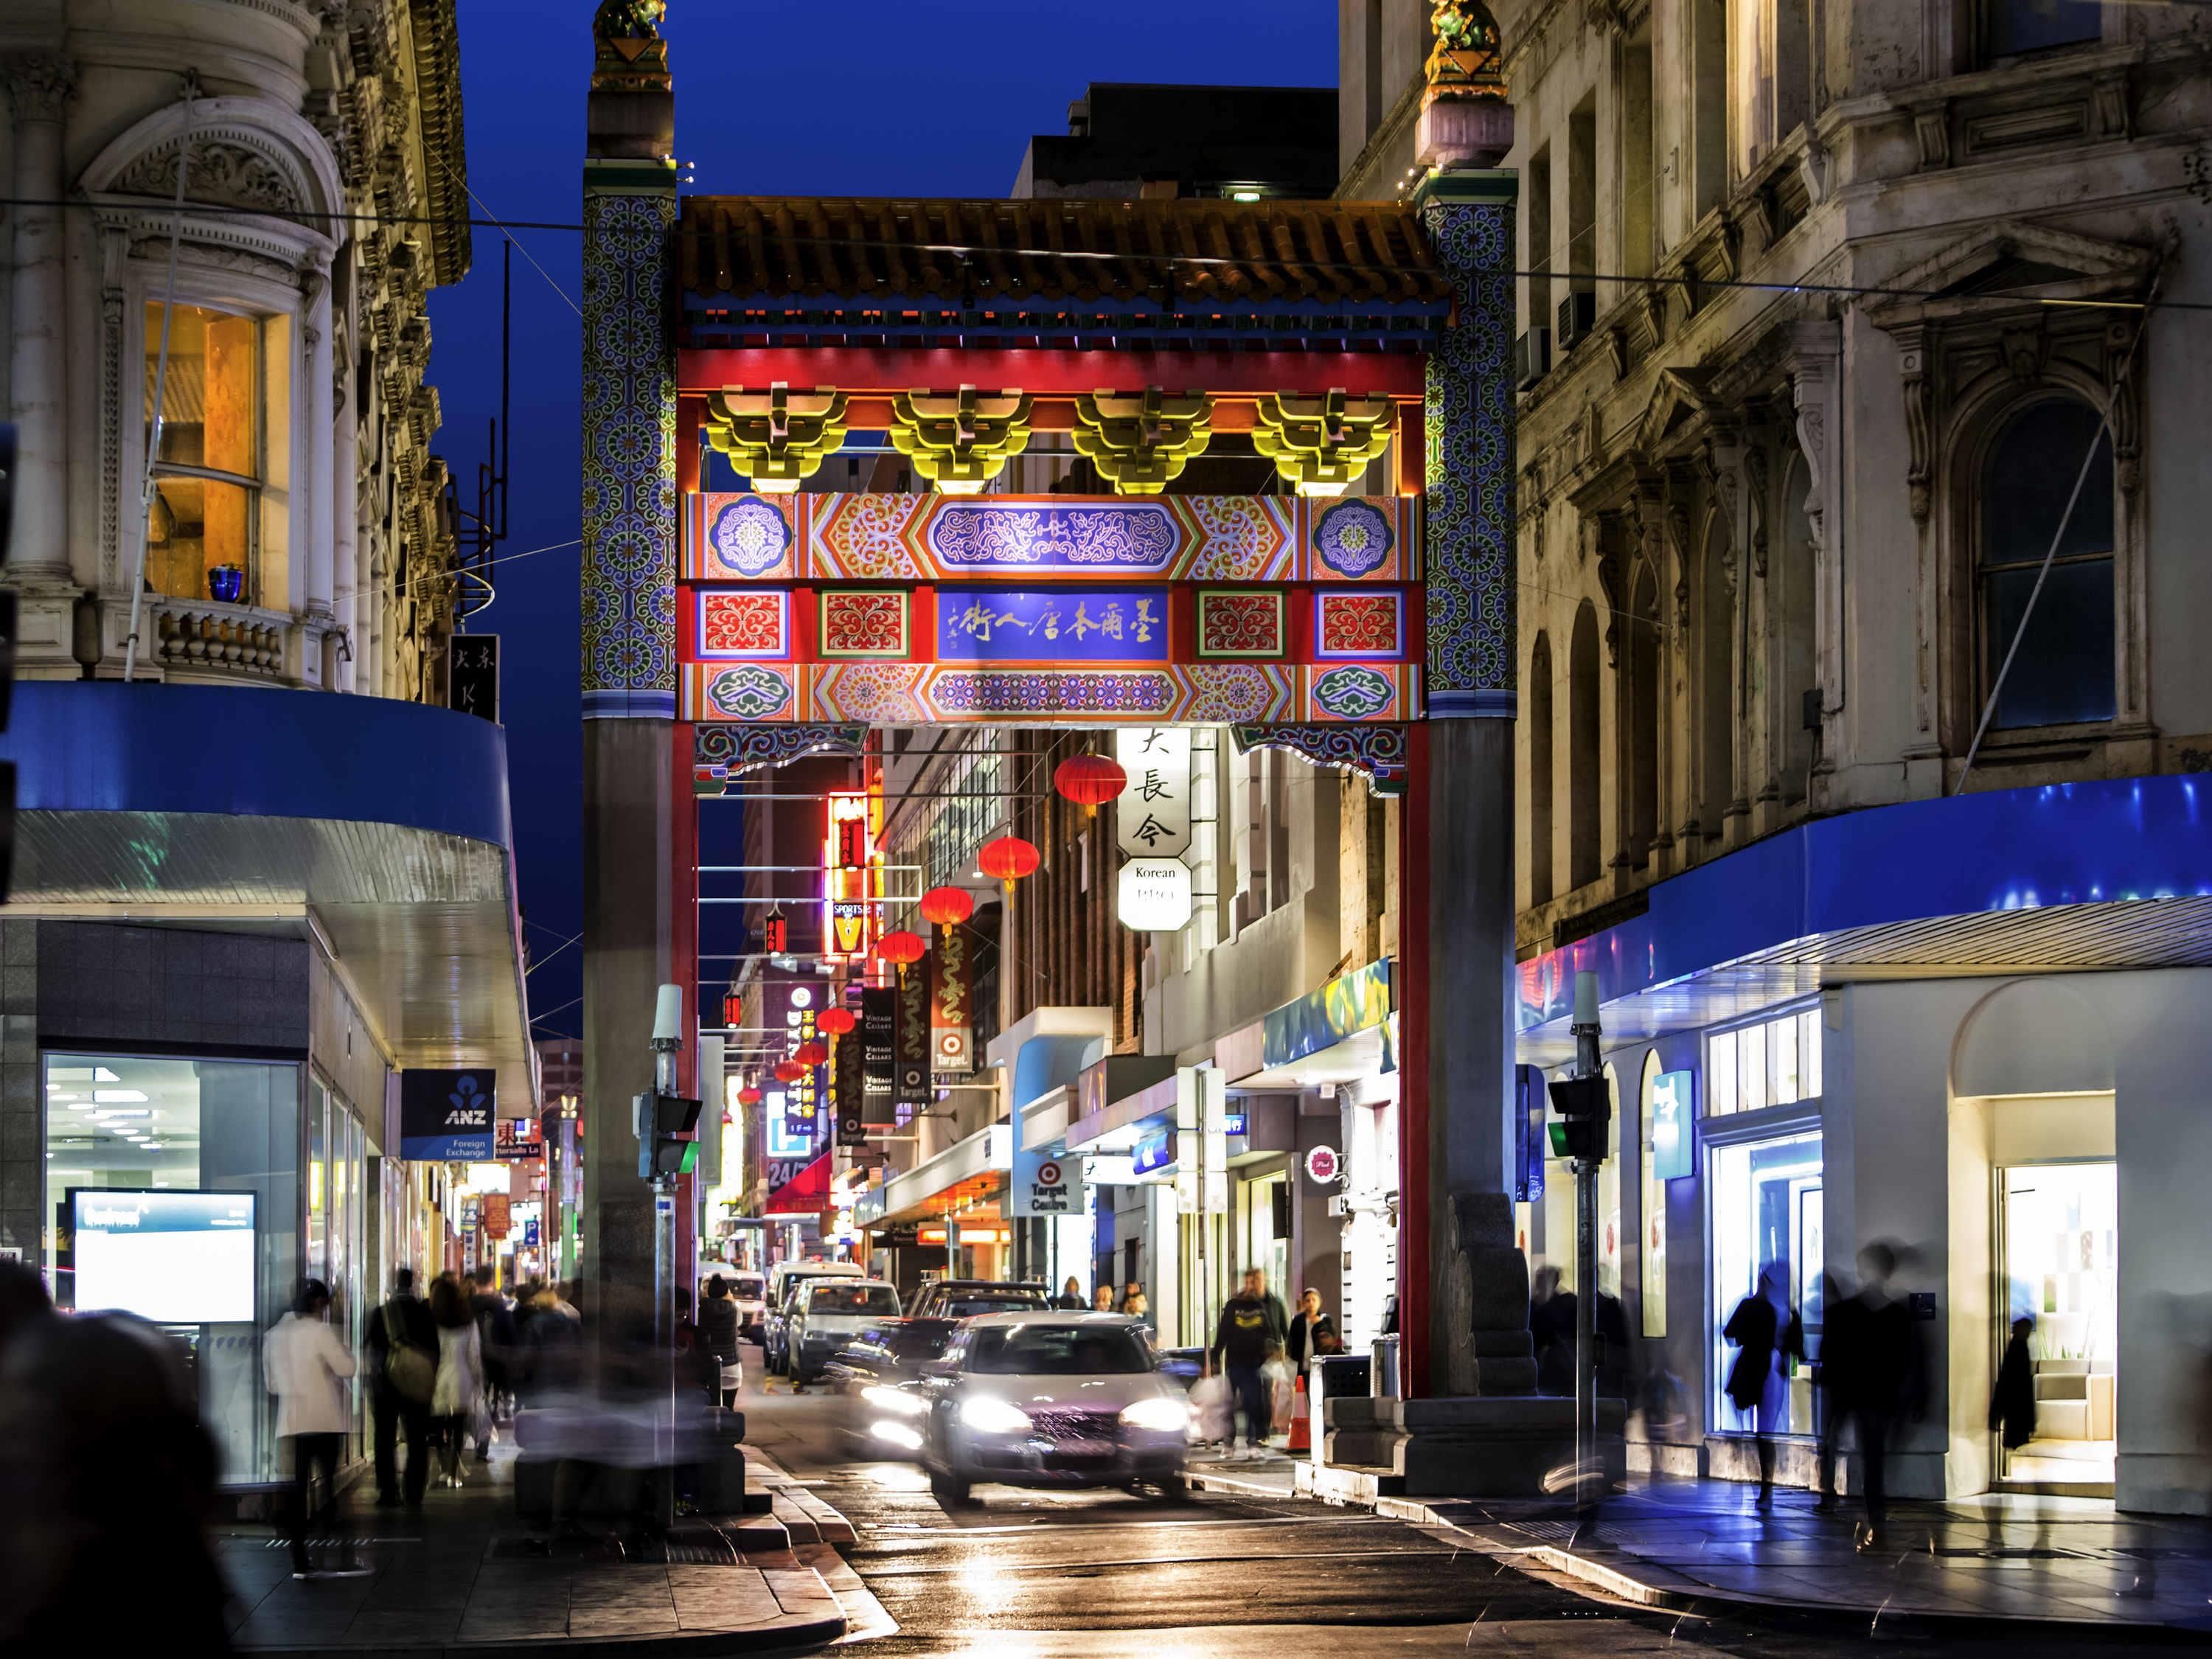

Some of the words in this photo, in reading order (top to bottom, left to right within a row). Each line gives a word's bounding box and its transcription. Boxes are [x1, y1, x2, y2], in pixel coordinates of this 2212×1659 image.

[1133, 727, 1176, 847] 大長今
[1135, 867, 1175, 878] Korean
[834, 904, 863, 914] SPORTS
[445, 1110, 487, 1124] ANZ
[497, 1123, 515, 1146] 東
[453, 1140, 485, 1149] Foreign
[446, 1149, 485, 1158] Exchange
[1032, 1183, 1068, 1197] Target
[1032, 1199, 1068, 1211] Centre
[527, 1222, 536, 1233] P
